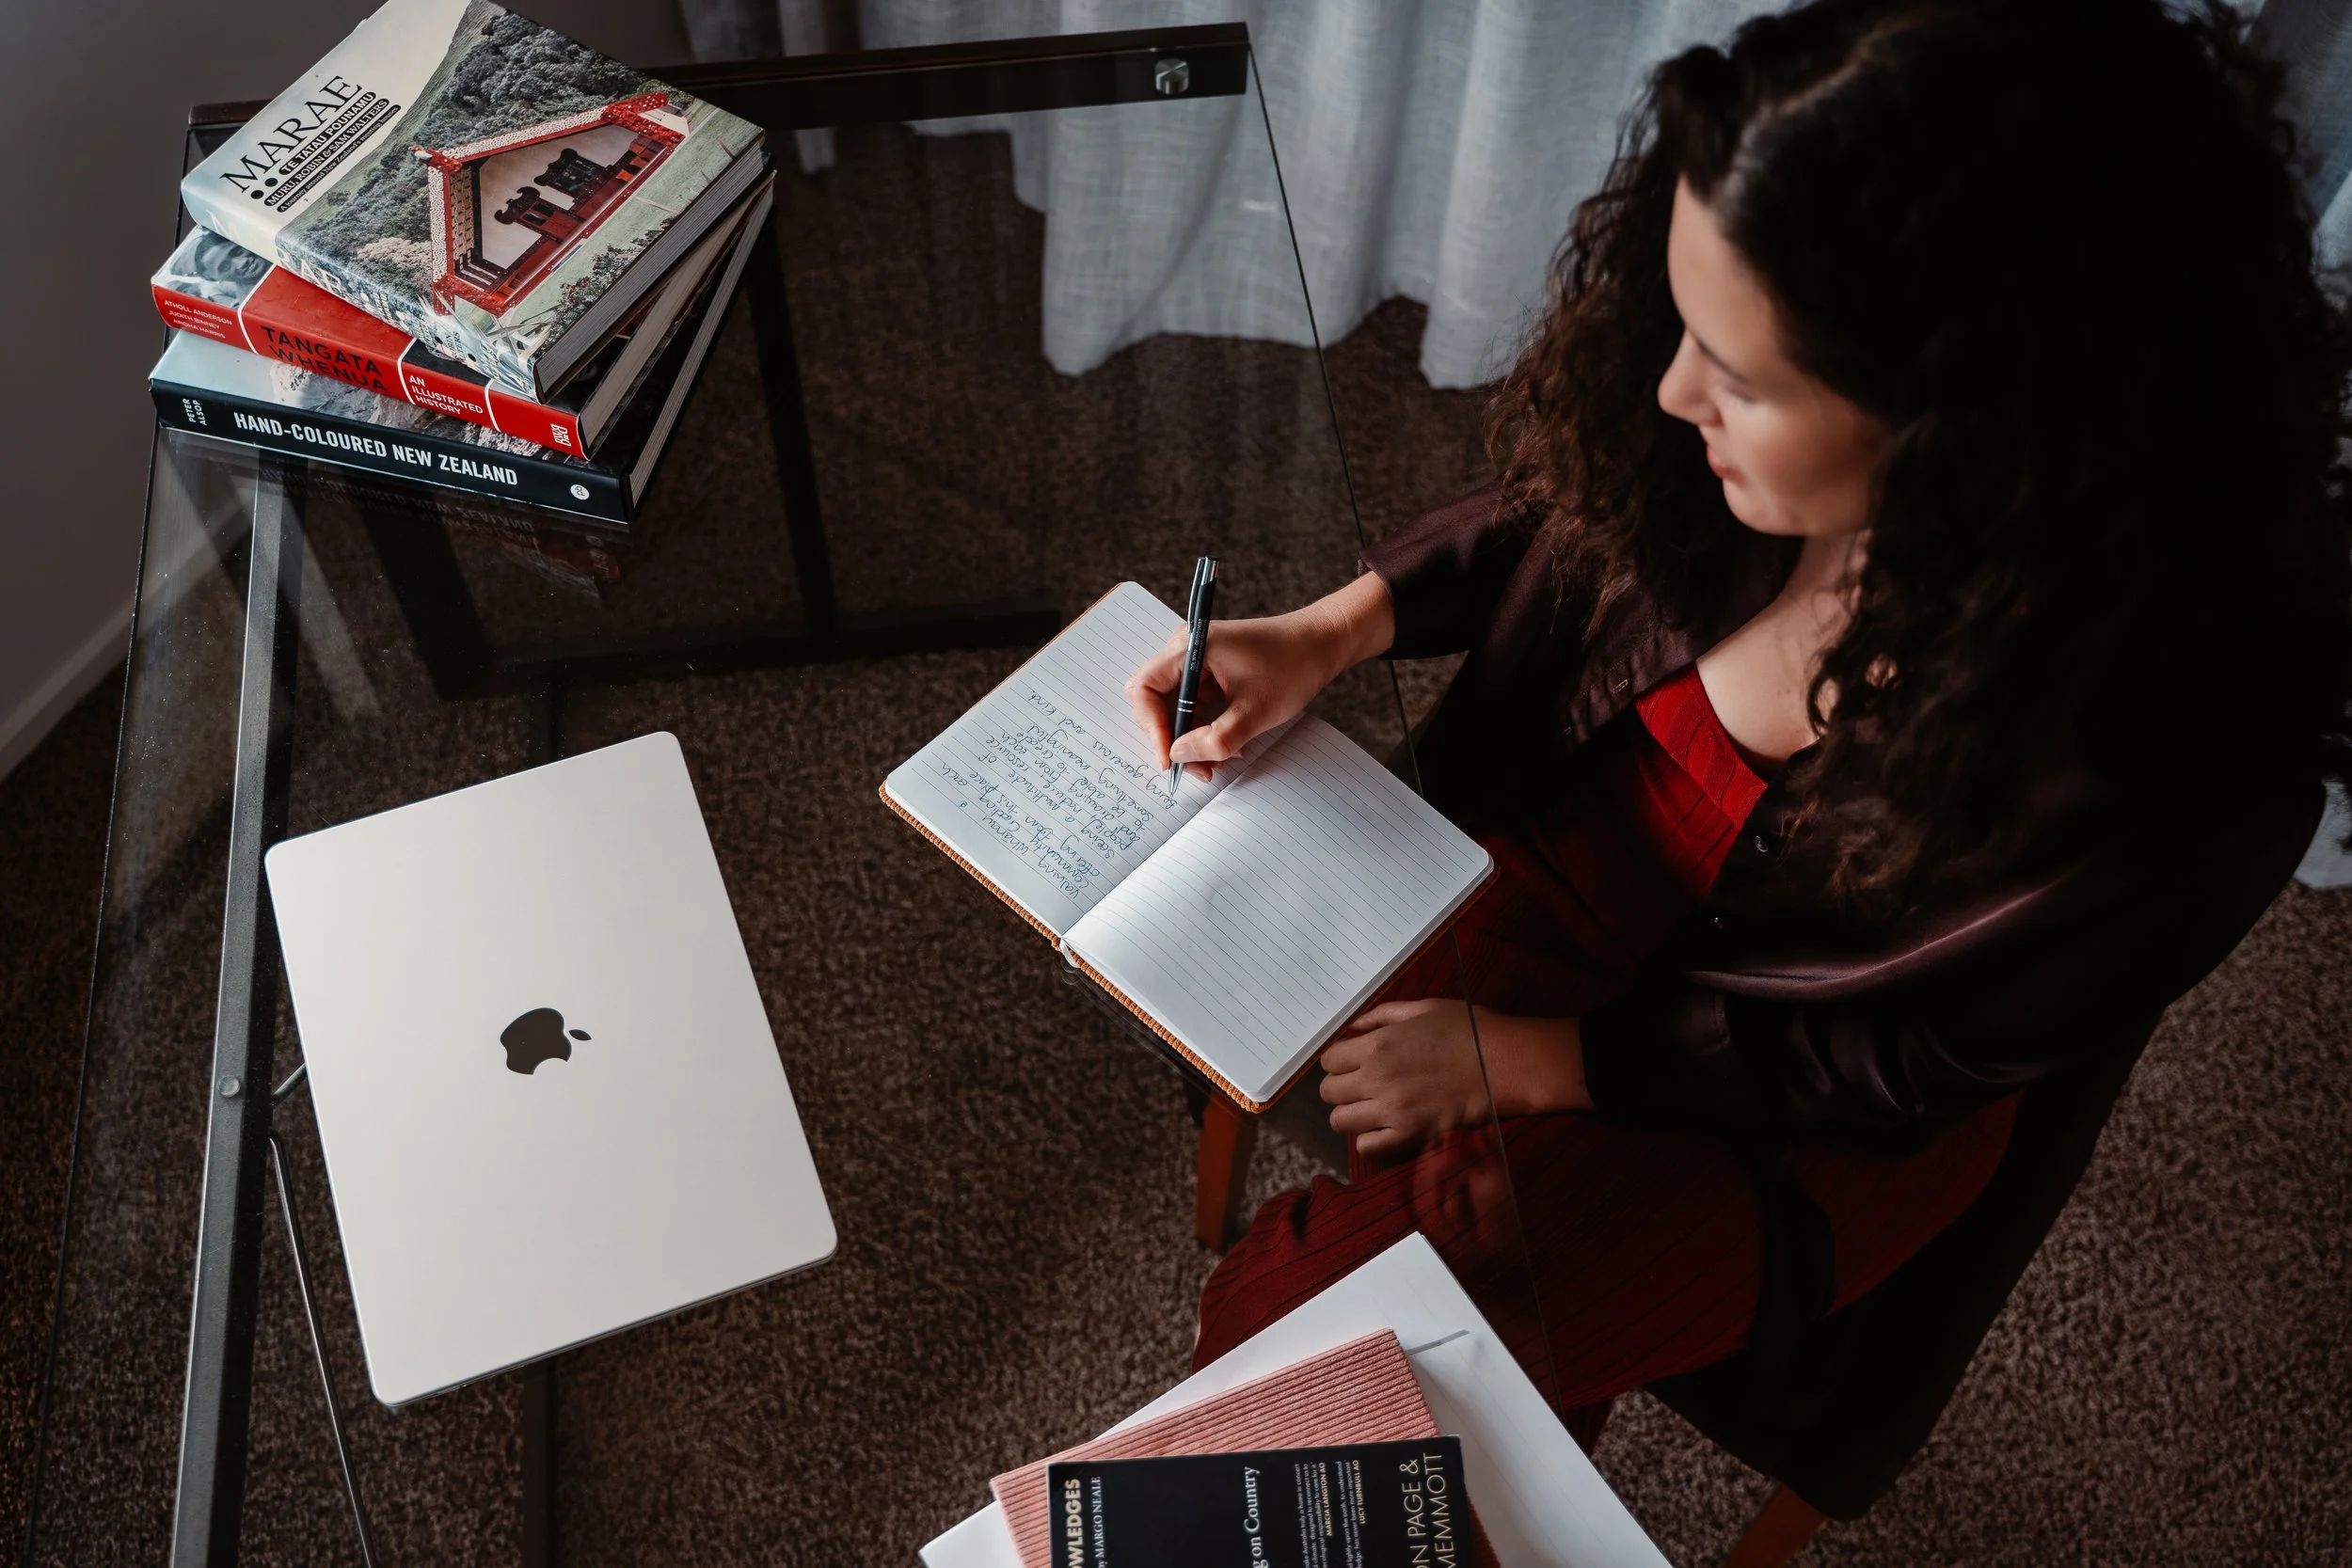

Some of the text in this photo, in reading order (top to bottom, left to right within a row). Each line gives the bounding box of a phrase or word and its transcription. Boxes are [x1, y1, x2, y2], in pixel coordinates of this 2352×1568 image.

[219, 75, 362, 194] MARAE
[281, 93, 374, 173] TE TATAU POUNAMU
[267, 100, 388, 205] MURU, ROBIN & SAM WALTERS
[305, 172, 326, 189] around
[324, 162, 338, 173] New
[334, 141, 361, 162] Zealand's
[360, 121, 383, 141] meeting
[378, 107, 399, 123] houses
[165, 300, 232, 325] ATHOLL ANDERSON
[168, 310, 194, 321] JUDITH
[261, 325, 383, 376] TANGATA
[268, 345, 391, 393] WHENUA
[409, 375, 425, 387] AN
[183, 398, 197, 424] PETER
[193, 400, 207, 426] ALSOP
[412, 385, 484, 414] ILLUSTRATED
[415, 394, 461, 415] HISTORY
[232, 411, 518, 485] HAND-COLOURED NEW ZEALAND
[1057, 716, 1086, 734] and
[985, 735, 1029, 772] resource
[1001, 731, 1026, 754] each
[977, 752, 997, 763] of
[1057, 762, 1070, 774] to
[1091, 740, 1149, 778] generous
[942, 762, 968, 787] each
[968, 771, 999, 794] place
[1008, 770, 1060, 810] multitude
[1079, 777, 1105, 800] able
[995, 793, 1017, 813] this
[1110, 803, 1126, 818] be
[1134, 818, 1145, 832] to
[1399, 1459, 1419, 1474] &
[1091, 1477, 1103, 1513] NEALE
[1244, 1466, 1260, 1532] Country
[1318, 1462, 1333, 1536] MARCIA LANGTON AO
[1352, 1460, 1366, 1524] LUCY TURNBULL AO
[1402, 1482, 1426, 1536] PAGE
[1423, 1452, 1456, 1568] MEMMOTT
[1092, 1514, 1104, 1558] MARGO
[1250, 1536, 1263, 1557] on
[1299, 1528, 1309, 1555] Australia
